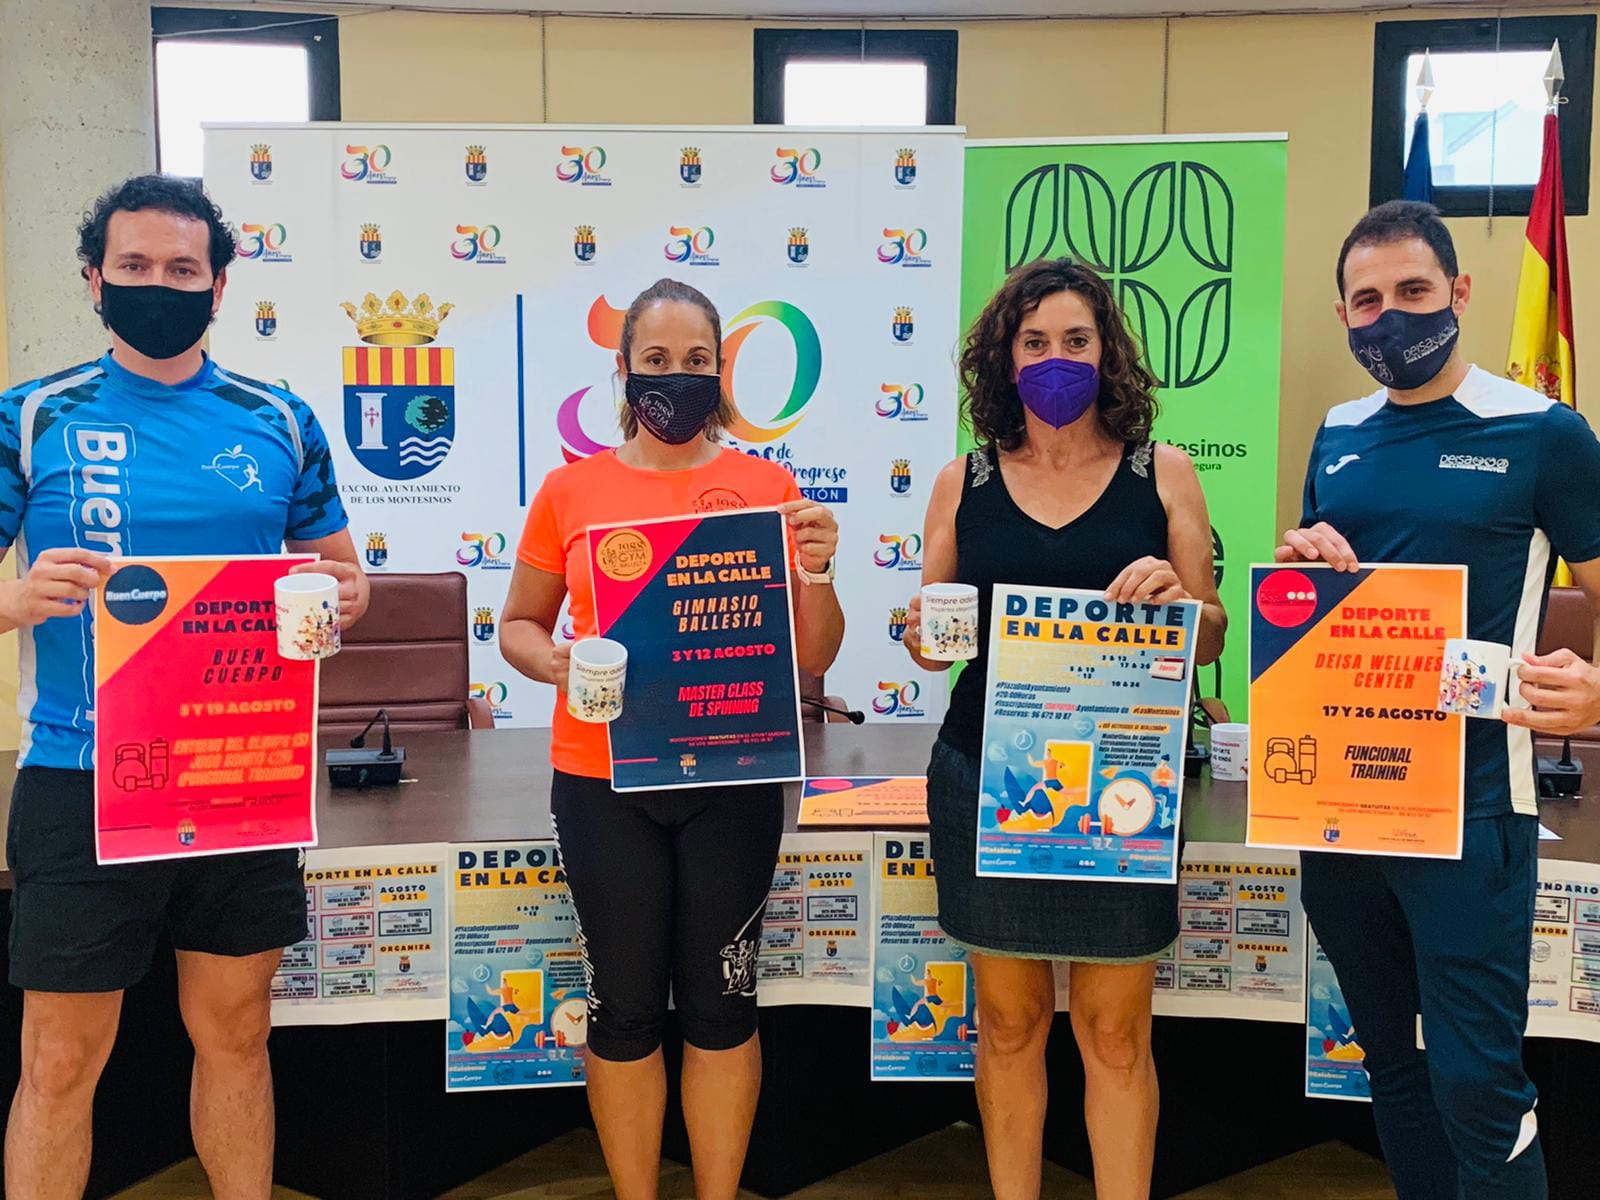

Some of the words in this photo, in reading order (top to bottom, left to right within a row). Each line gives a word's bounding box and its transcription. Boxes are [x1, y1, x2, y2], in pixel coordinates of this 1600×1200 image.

[342, 485, 380, 493] EXCMO.
[383, 485, 461, 493] AYUNTAMIENTO
[350, 496, 364, 504] DE
[366, 496, 385, 504] LOS
[387, 496, 453, 504] MONTESINOS
[619, 552, 646, 563] GYM
[676, 550, 757, 569] DEPORTE
[667, 573, 690, 586] EN
[694, 571, 716, 584] LA
[718, 566, 771, 582] CALLE
[194, 600, 274, 615] DEPORT
[672, 595, 759, 616] GIMNASIO
[1005, 594, 1185, 627] DEPORTE
[1342, 607, 1431, 621] DEPORTE
[183, 620, 209, 634] EN
[213, 620, 236, 633] LA
[241, 618, 277, 632] CAL
[678, 612, 762, 633] BALLESTA
[1007, 621, 1040, 637] EN
[1053, 624, 1084, 640] LA
[1097, 627, 1180, 646] CALLE
[1330, 625, 1355, 637] EN
[1360, 625, 1383, 638] LA
[1387, 626, 1446, 640] CALLE
[213, 647, 265, 666] BUEN
[672, 651, 681, 662] 3
[684, 650, 693, 661] Y
[694, 649, 710, 660] 12
[714, 644, 776, 660] AGOSTO
[1315, 653, 1362, 669] DEISA
[1370, 655, 1443, 672] WELLNES
[203, 665, 282, 684] CUERPO
[1353, 672, 1415, 689] CENTER
[678, 684, 725, 702] MASTER
[728, 681, 764, 697] CLASS
[227, 699, 297, 715] AGOSTO
[689, 703, 704, 717] DE
[706, 700, 760, 716] SPINNING
[1323, 706, 1339, 716] 17
[1341, 706, 1352, 717] Y
[1355, 707, 1375, 718] 26
[1378, 708, 1447, 721] AGOSTO
[1344, 745, 1412, 763] FUNCIONAL
[1350, 764, 1408, 781] TRAINING
[806, 854, 820, 862] LA
[825, 853, 863, 862] CALLE
[306, 871, 349, 880] PORTE
[355, 869, 371, 877] EN
[377, 868, 392, 876] LA
[398, 865, 438, 875] CALLE
[887, 862, 915, 876] EN
[1215, 865, 1231, 873] EN
[1236, 866, 1251, 874] LA
[1257, 867, 1297, 876] CALLE
[461, 873, 489, 886] EN
[500, 871, 527, 885] LA
[537, 870, 566, 884] CA
[380, 885, 426, 893] AGOSTO
[1239, 884, 1285, 892] AGOSTO
[392, 893, 418, 901] 2021
[380, 944, 431, 952] ORGANIZA
[1237, 944, 1288, 952] ORGANIZA
